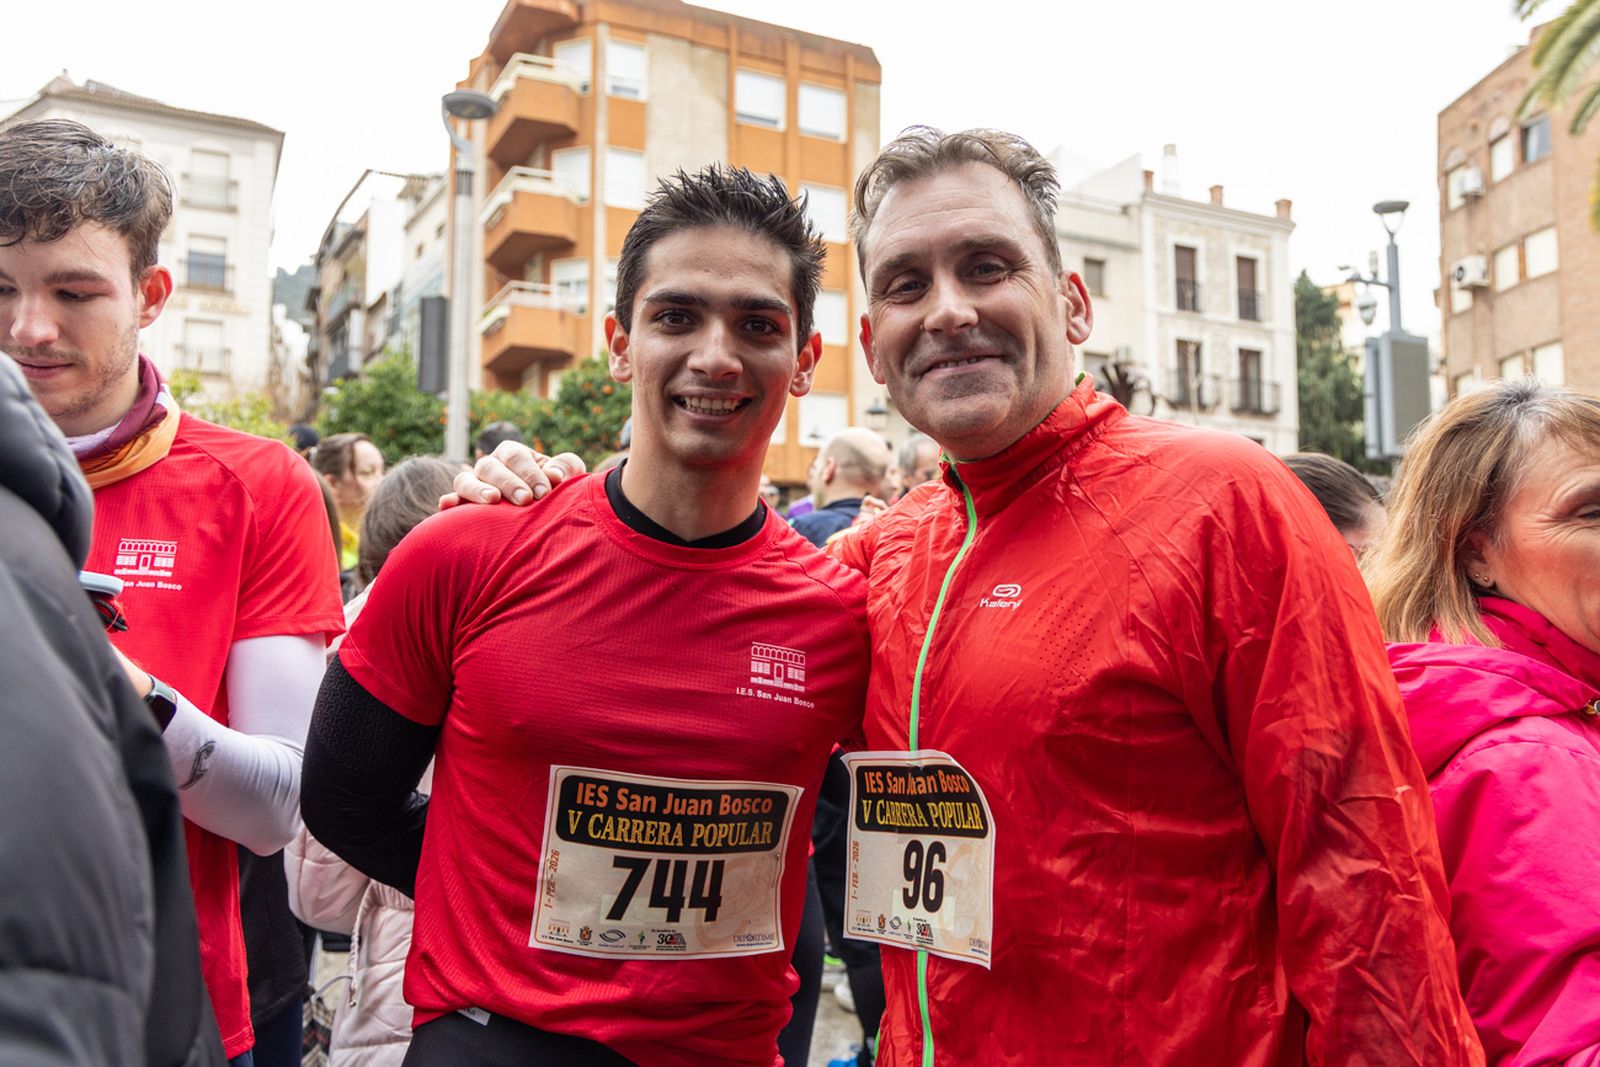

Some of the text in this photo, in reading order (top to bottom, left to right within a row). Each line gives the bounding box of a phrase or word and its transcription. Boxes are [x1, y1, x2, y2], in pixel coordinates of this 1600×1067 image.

[157, 581, 182, 590] Bosco
[756, 689, 772, 700] San
[773, 693, 793, 704] Juan
[793, 696, 815, 709] Bosco
[864, 771, 885, 794] IES
[885, 771, 906, 795] San
[937, 769, 971, 794] Bosco
[576, 782, 774, 816] IES San Juan Bosco
[567, 809, 774, 848] V CARRERA POPULAR
[862, 799, 873, 824] V
[927, 801, 984, 830] POPULAR
[550, 848, 561, 873] 2026
[852, 840, 860, 863] 2026
[605, 855, 726, 923] 744
[902, 839, 947, 913] 96
